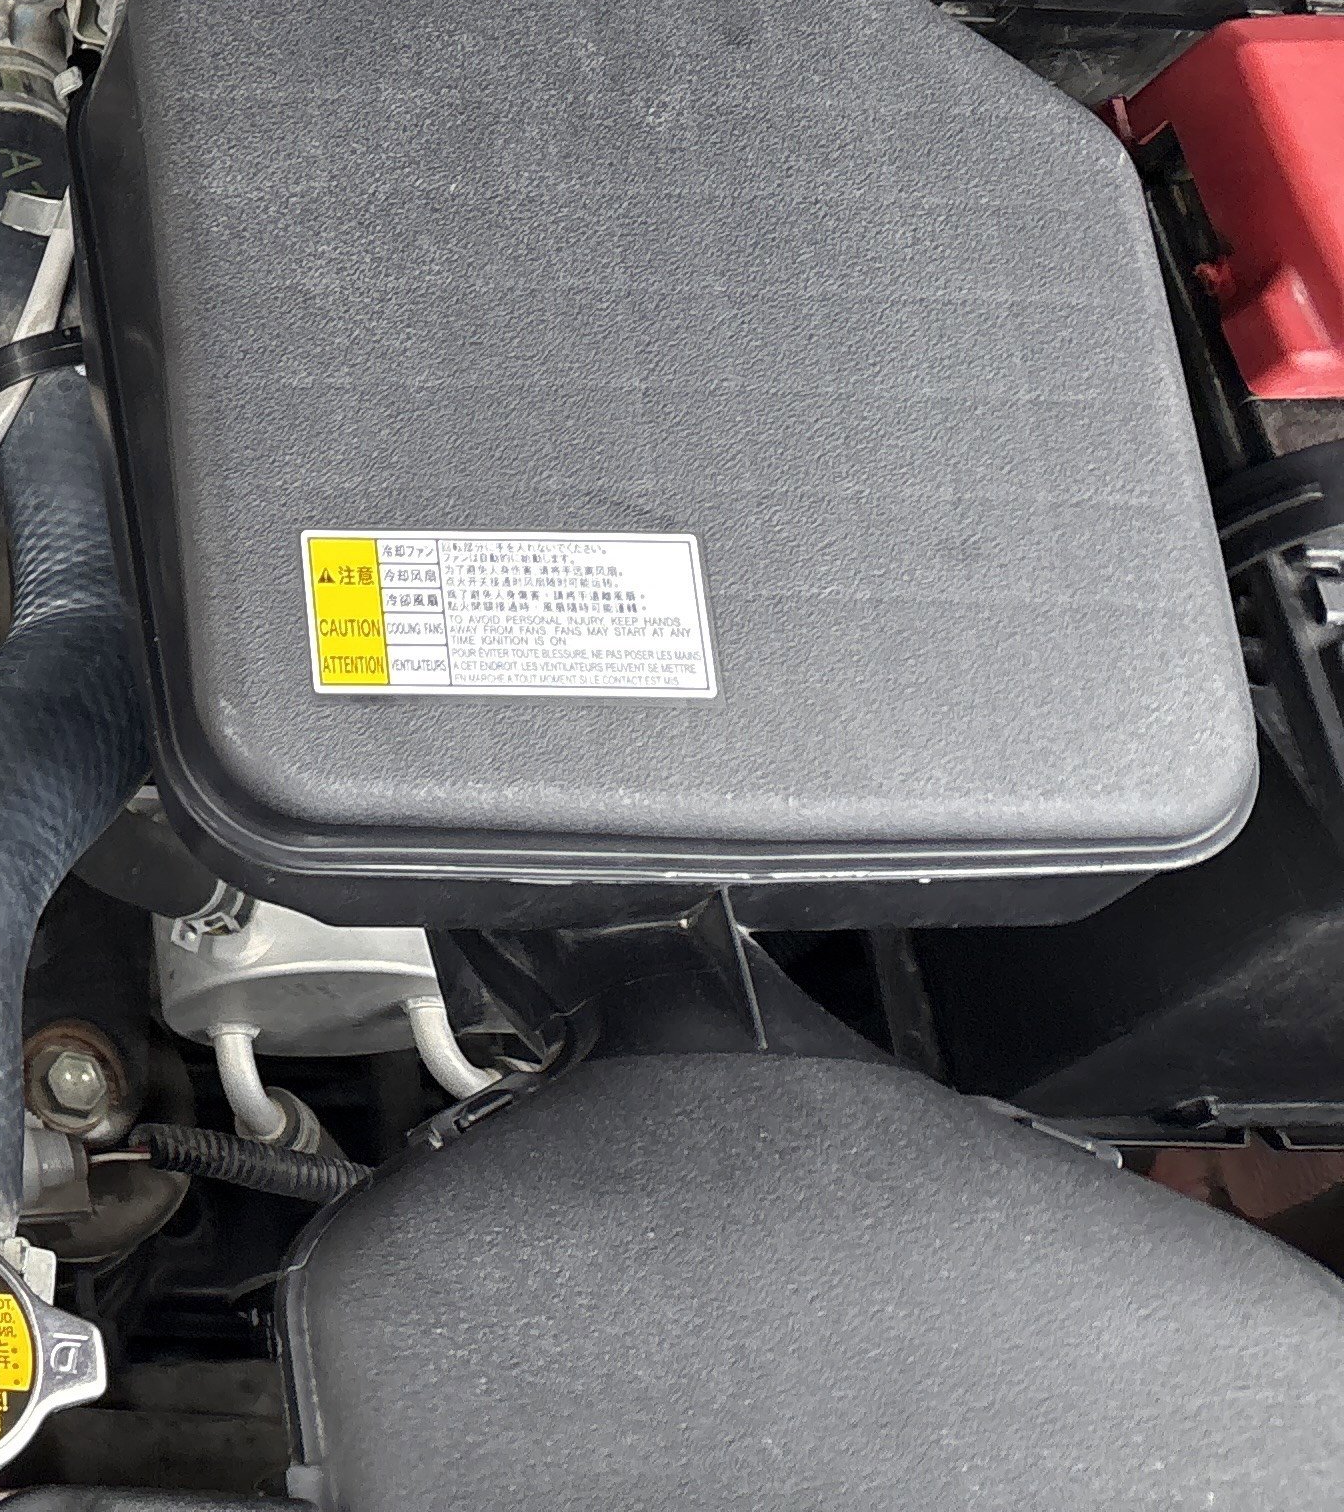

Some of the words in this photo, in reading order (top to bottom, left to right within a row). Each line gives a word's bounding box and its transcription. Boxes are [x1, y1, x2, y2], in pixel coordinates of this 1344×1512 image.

[339, 566, 374, 585] 注意
[450, 615, 463, 624] TO
[468, 615, 500, 624] AVOID
[505, 615, 562, 625] PERSONAL
[611, 617, 639, 626] KEEP
[644, 617, 681, 627] HANDS
[319, 619, 381, 637] CAUTION
[387, 623, 421, 635] COOLING
[424, 623, 444, 635] FANS
[450, 625, 477, 635] AWAY
[483, 626, 513, 635] FROM
[554, 627, 582, 636] FANS
[587, 627, 609, 636] MAY
[614, 627, 646, 636] START
[652, 628, 664, 637] AT
[670, 628, 691, 637] ANY
[451, 635, 475, 645] TIME
[481, 636, 529, 645] IGNITION
[534, 636, 544, 645] IS
[625, 650, 654, 660] POSER
[323, 656, 384, 674] ATTENTION
